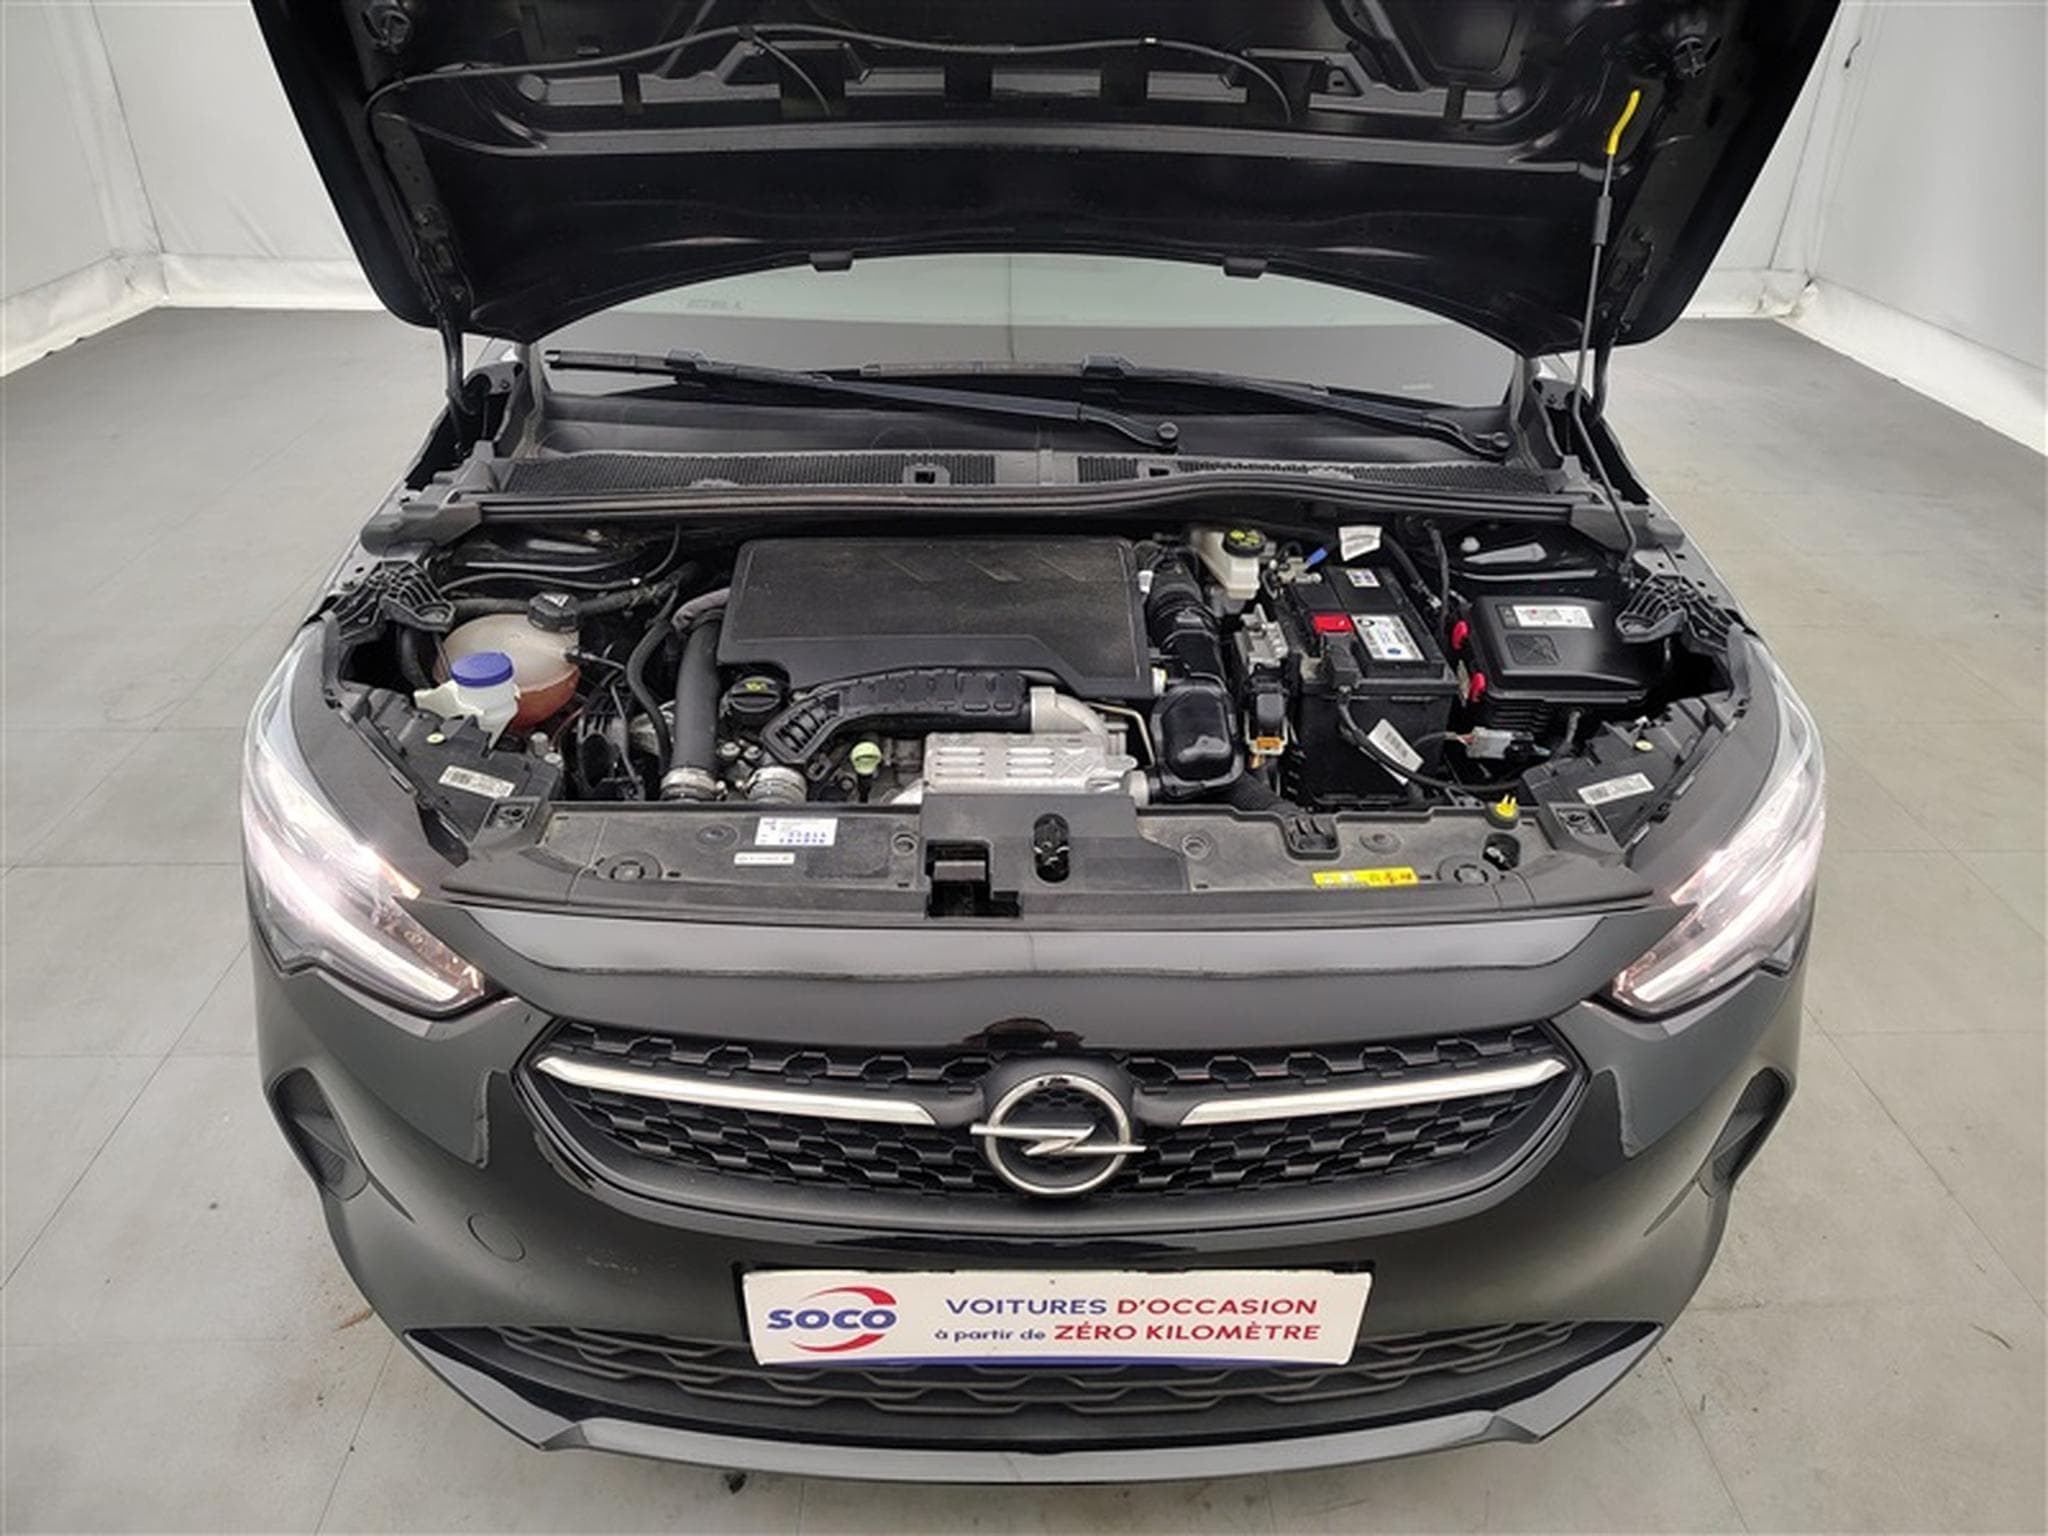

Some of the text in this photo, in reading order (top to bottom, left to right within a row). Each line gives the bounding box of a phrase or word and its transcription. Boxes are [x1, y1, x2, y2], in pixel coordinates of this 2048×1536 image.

[946, 1299, 1318, 1315] VOITURES D'OCCASION
[767, 1309, 897, 1330] SOCO
[934, 1321, 1320, 1342] à partir de ZÉRO KILOMÈTRE
